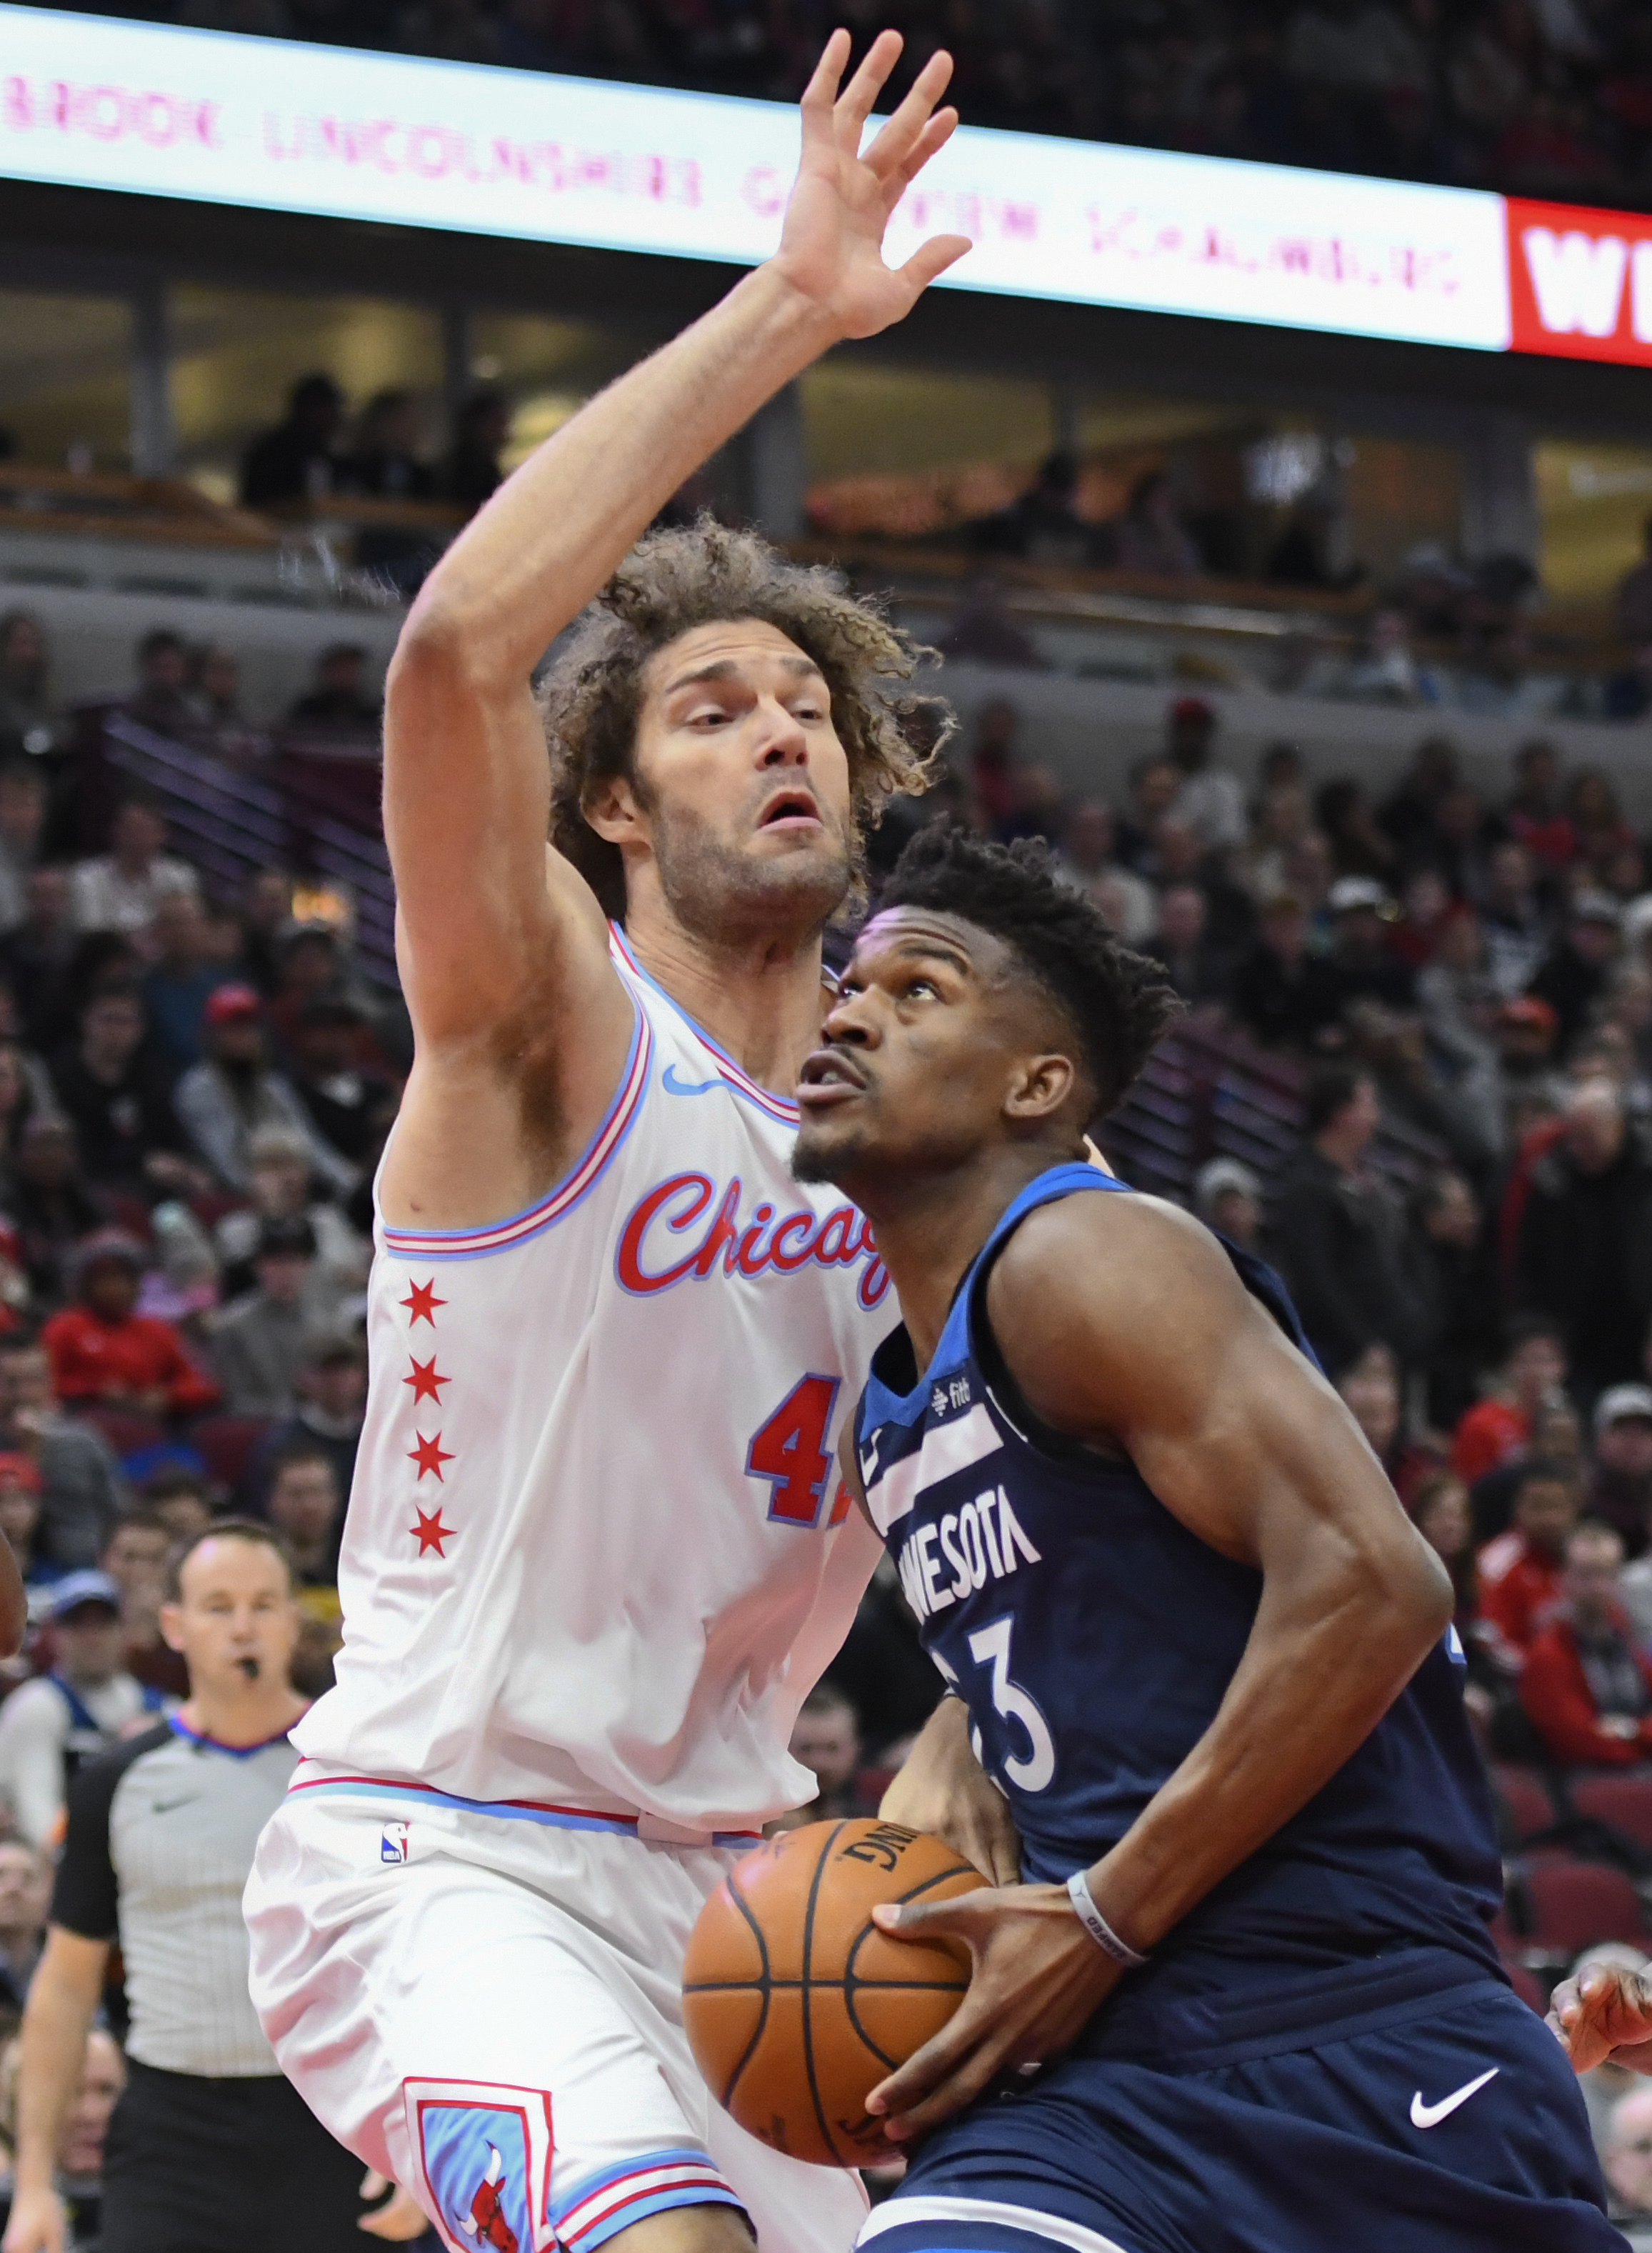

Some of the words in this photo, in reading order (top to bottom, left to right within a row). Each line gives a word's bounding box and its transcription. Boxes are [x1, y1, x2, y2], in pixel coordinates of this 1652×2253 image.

[744, 1372, 852, 1531] 4
[898, 1484, 1042, 1626] NESOTA
[931, 1614, 1055, 1799] 3
